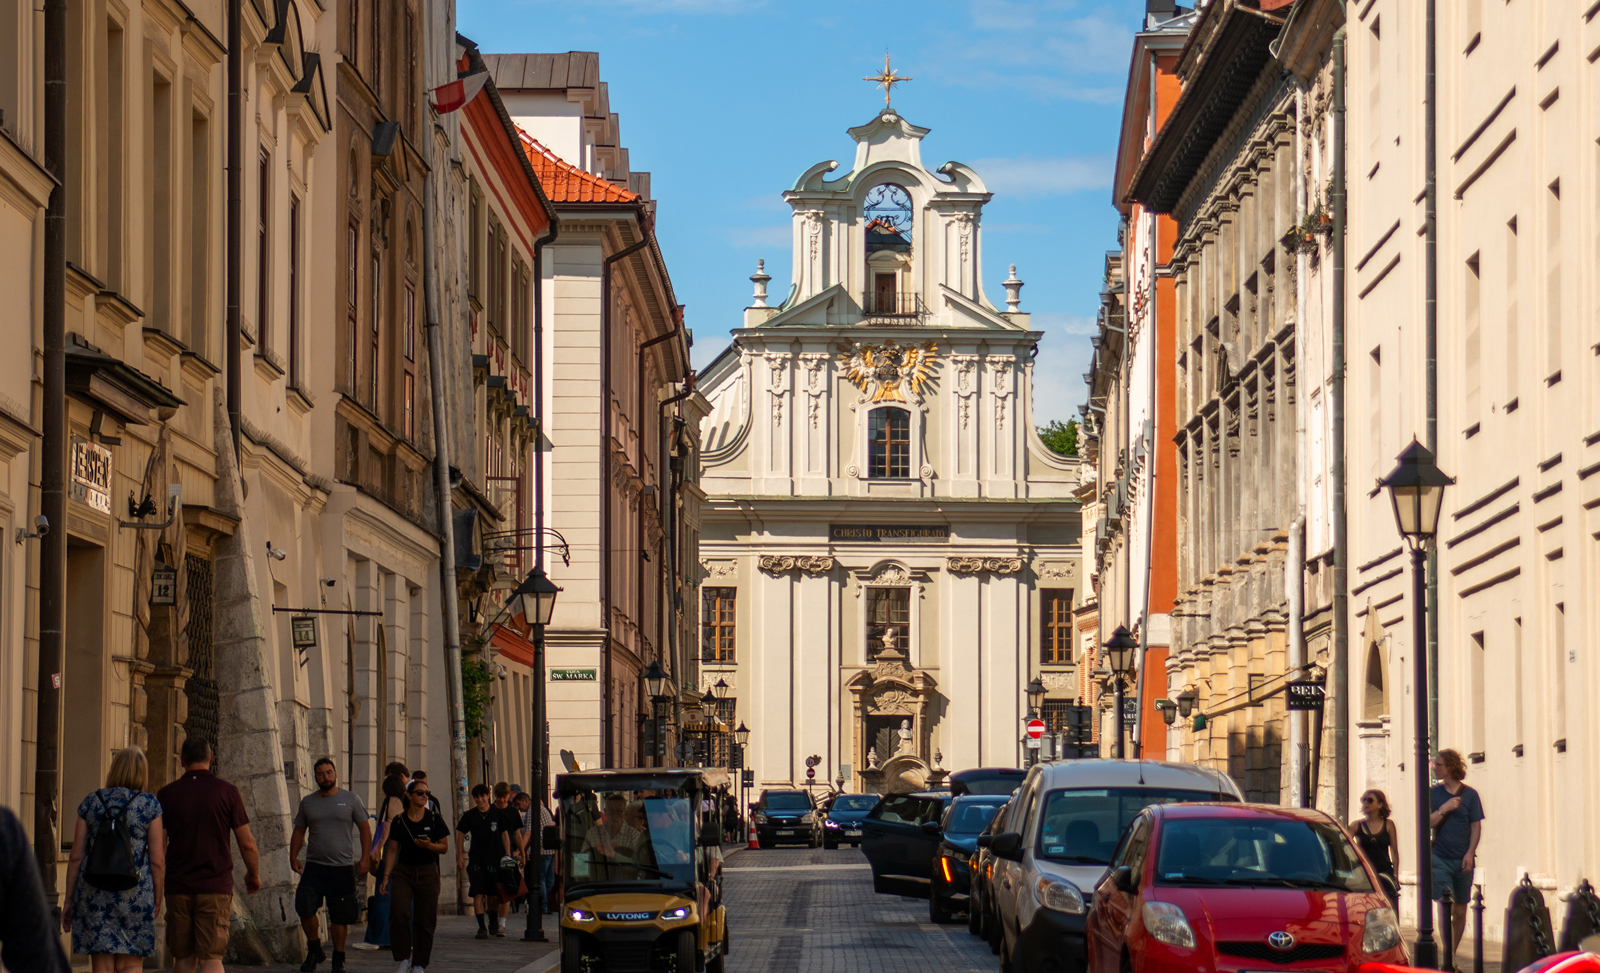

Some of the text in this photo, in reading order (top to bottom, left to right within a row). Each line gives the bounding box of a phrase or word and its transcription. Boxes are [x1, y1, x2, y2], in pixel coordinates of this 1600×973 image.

[833, 528, 872, 538] CHRISTO
[157, 584, 170, 597] 12
[606, 912, 650, 920] LVTONG
